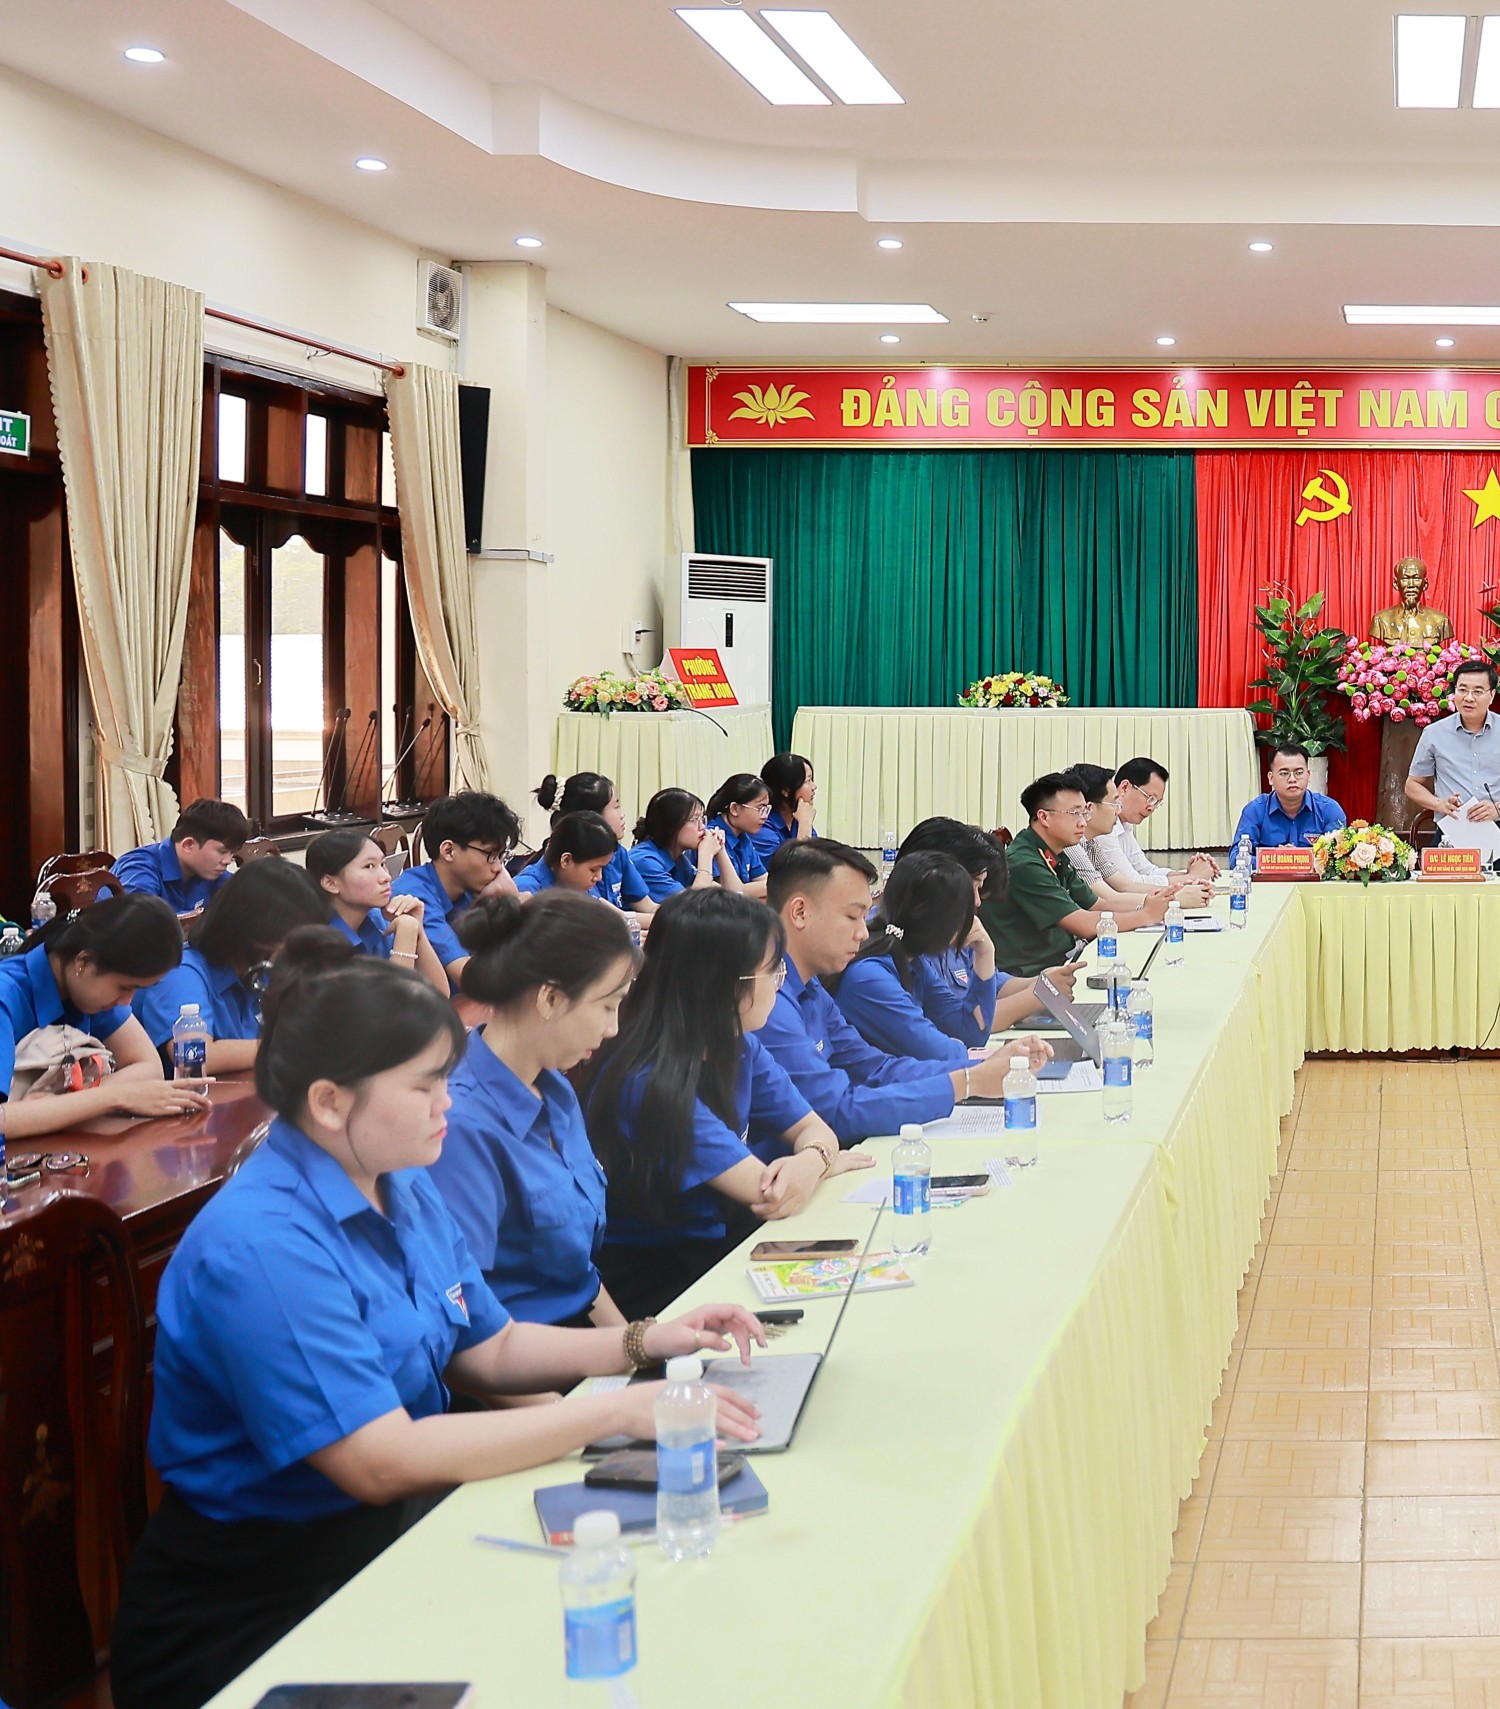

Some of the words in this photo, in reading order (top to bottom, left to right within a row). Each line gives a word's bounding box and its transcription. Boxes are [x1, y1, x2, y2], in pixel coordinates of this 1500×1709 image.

[841, 375, 970, 428] ĐẢNG
[987, 380, 1115, 435] CỘNG
[1131, 376, 1229, 428] SẢN
[1240, 381, 1345, 435] VIỆT
[1359, 389, 1468, 429] NAM
[0, 416, 13, 432] IT
[0, 433, 18, 447] OÁT
[681, 655, 718, 676] PHƯỜNG
[684, 678, 716, 700] TRẢNG
[711, 682, 735, 698] BOM
